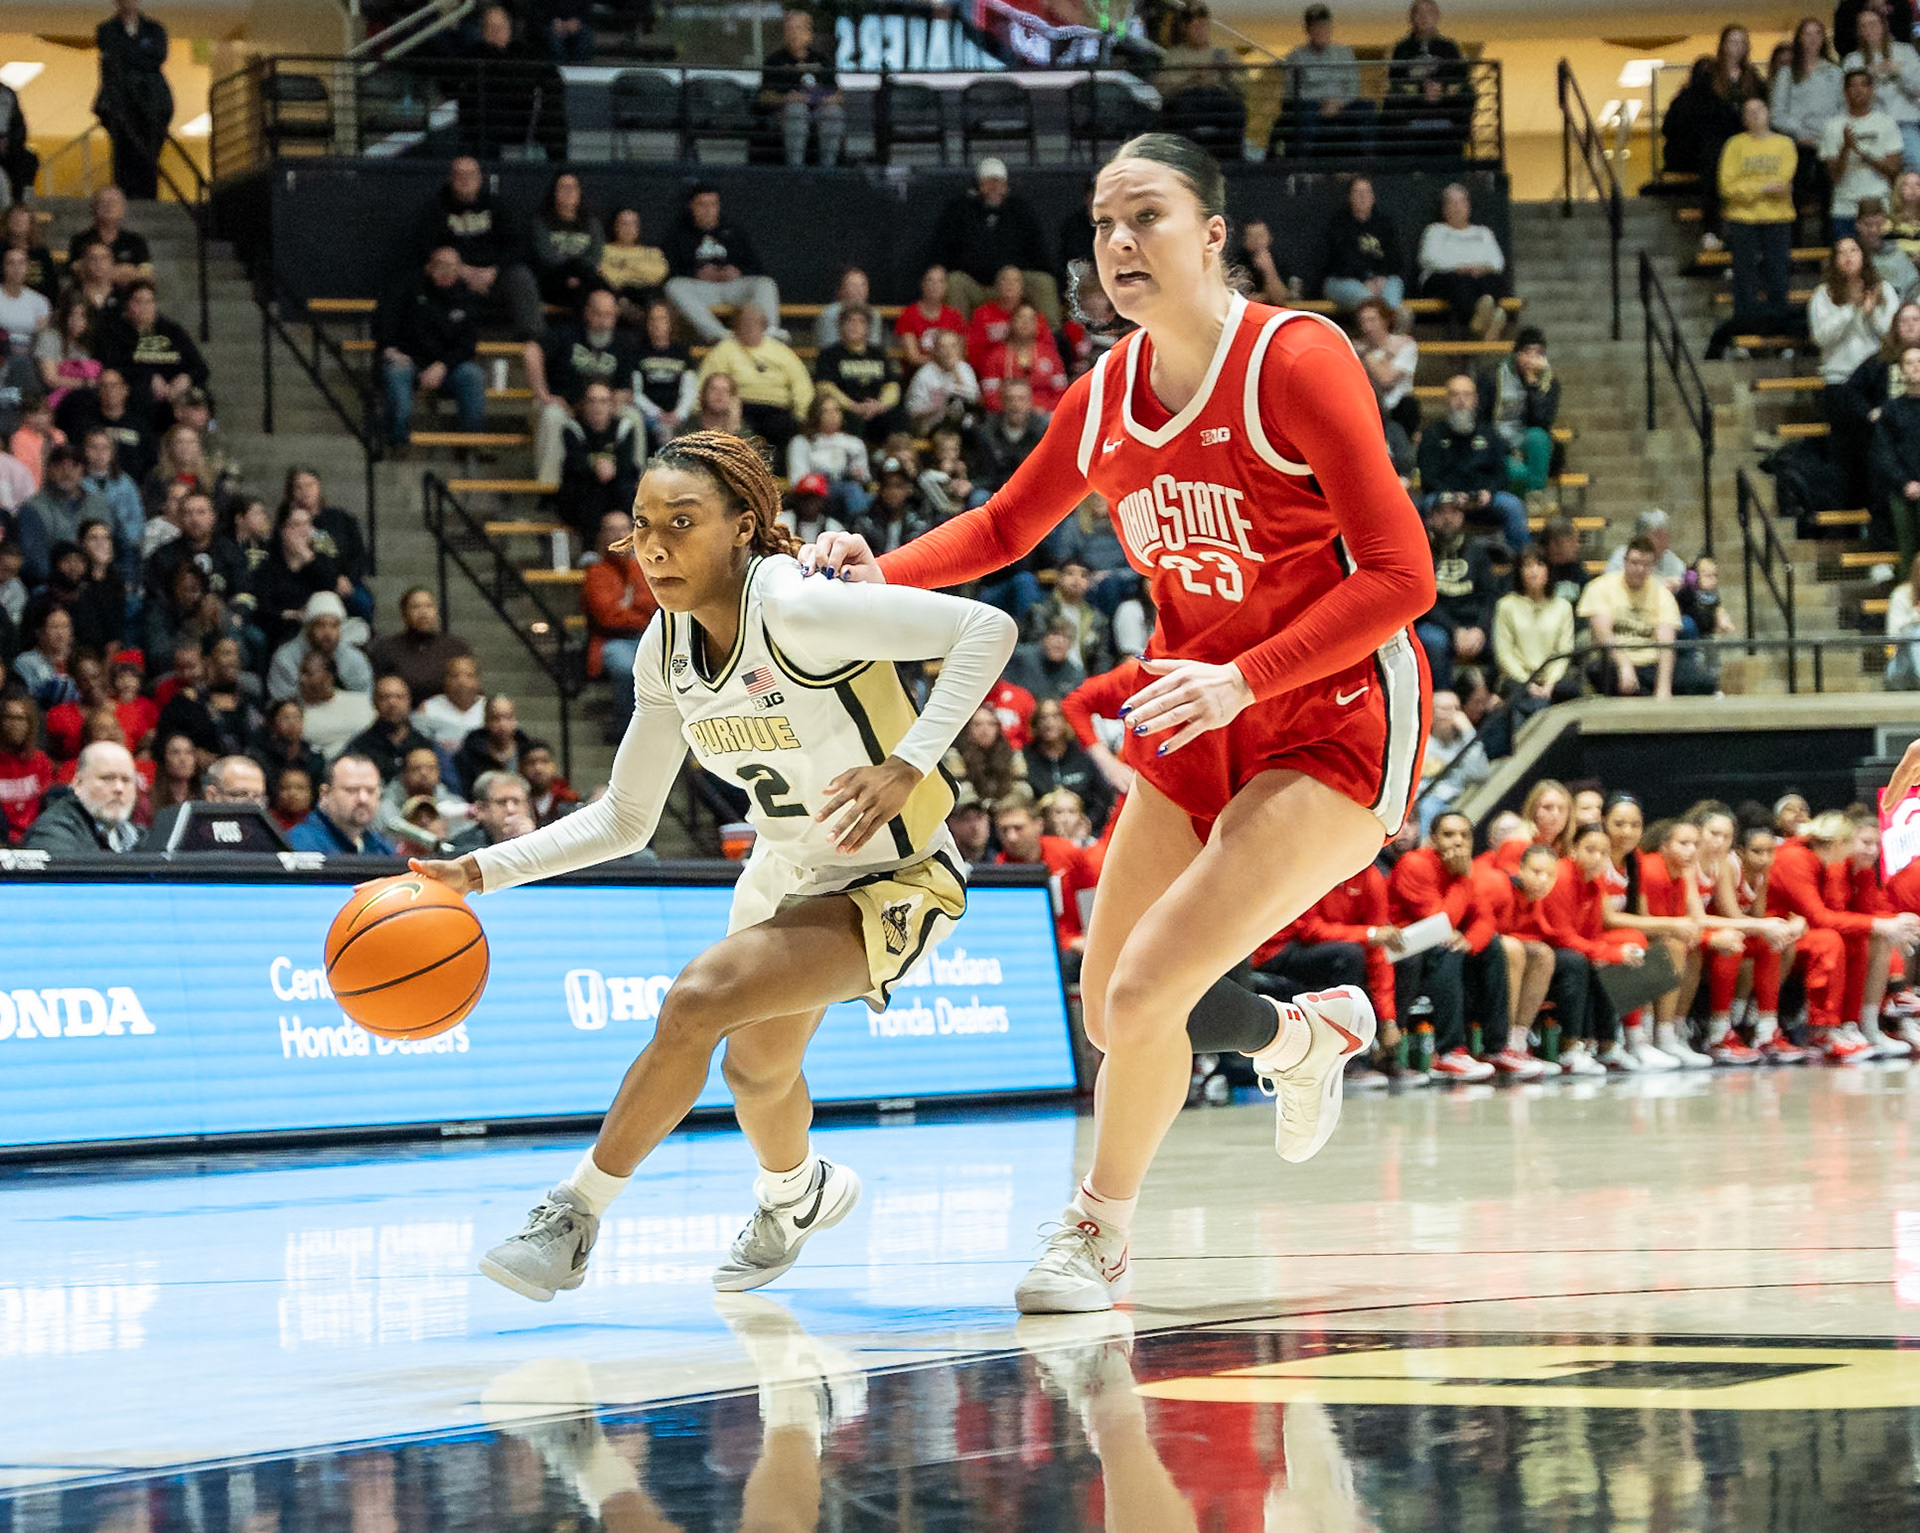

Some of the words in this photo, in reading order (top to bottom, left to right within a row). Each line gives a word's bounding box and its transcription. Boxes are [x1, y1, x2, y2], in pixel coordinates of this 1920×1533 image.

[1153, 474, 1265, 562] STATE
[1159, 551, 1244, 602] 23
[688, 716, 801, 757] PURDUE
[736, 764, 810, 817] 2
[605, 975, 674, 1021] HO
[867, 996, 935, 1037] Honda
[935, 994, 1009, 1035] Dealers
[279, 1014, 370, 1059] Honda
